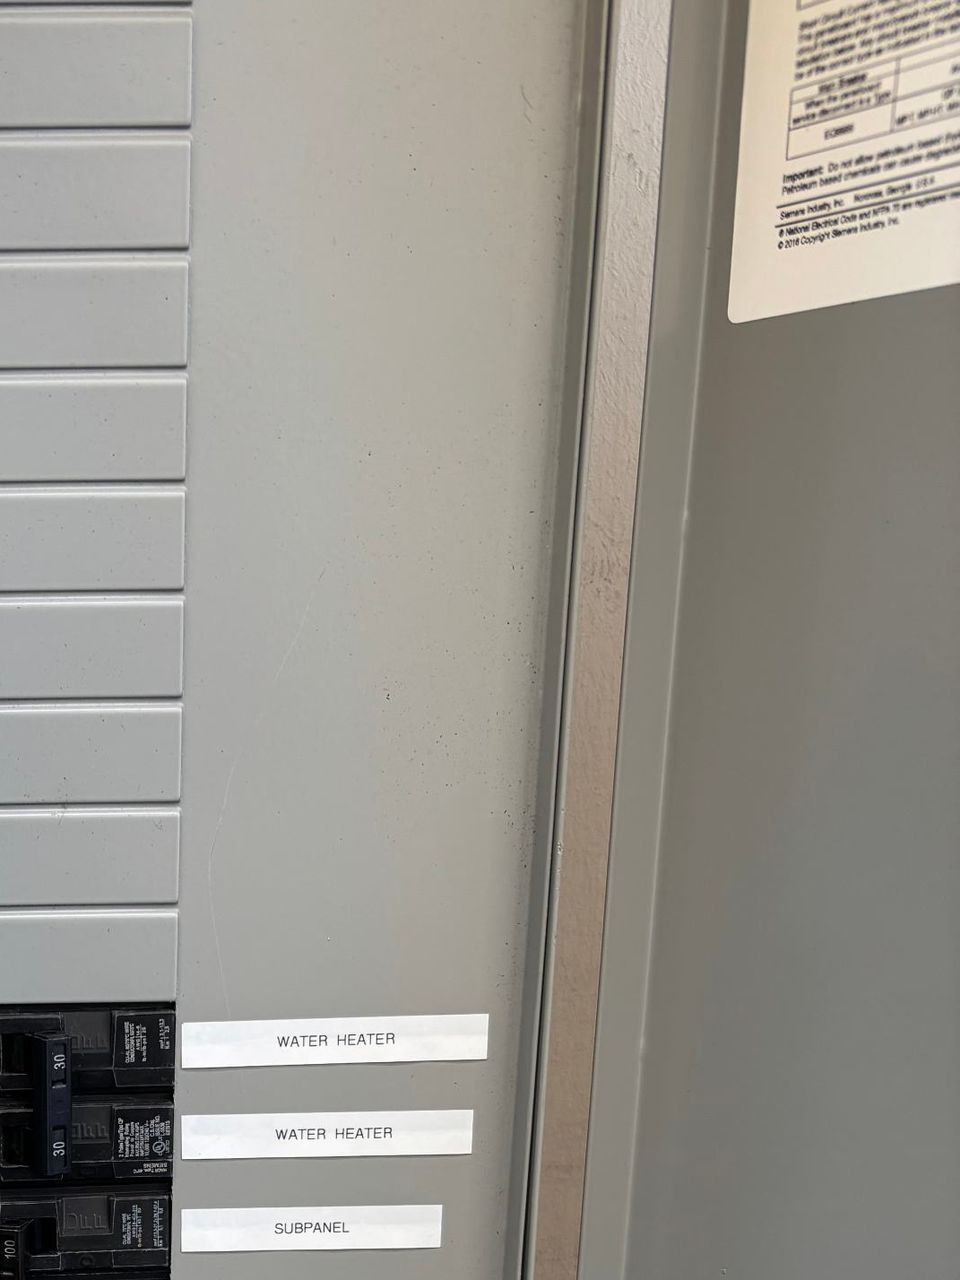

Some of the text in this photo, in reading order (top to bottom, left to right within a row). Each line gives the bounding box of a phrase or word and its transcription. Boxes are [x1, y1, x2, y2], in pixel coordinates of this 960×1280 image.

[277, 1033, 395, 1048] WATER HEATER
[53, 1053, 66, 1070] 30
[275, 1127, 393, 1141] WATER HEATER
[52, 1140, 66, 1157] 30
[274, 1221, 350, 1235] SUBPANEL
[3, 1240, 17, 1259] 100
